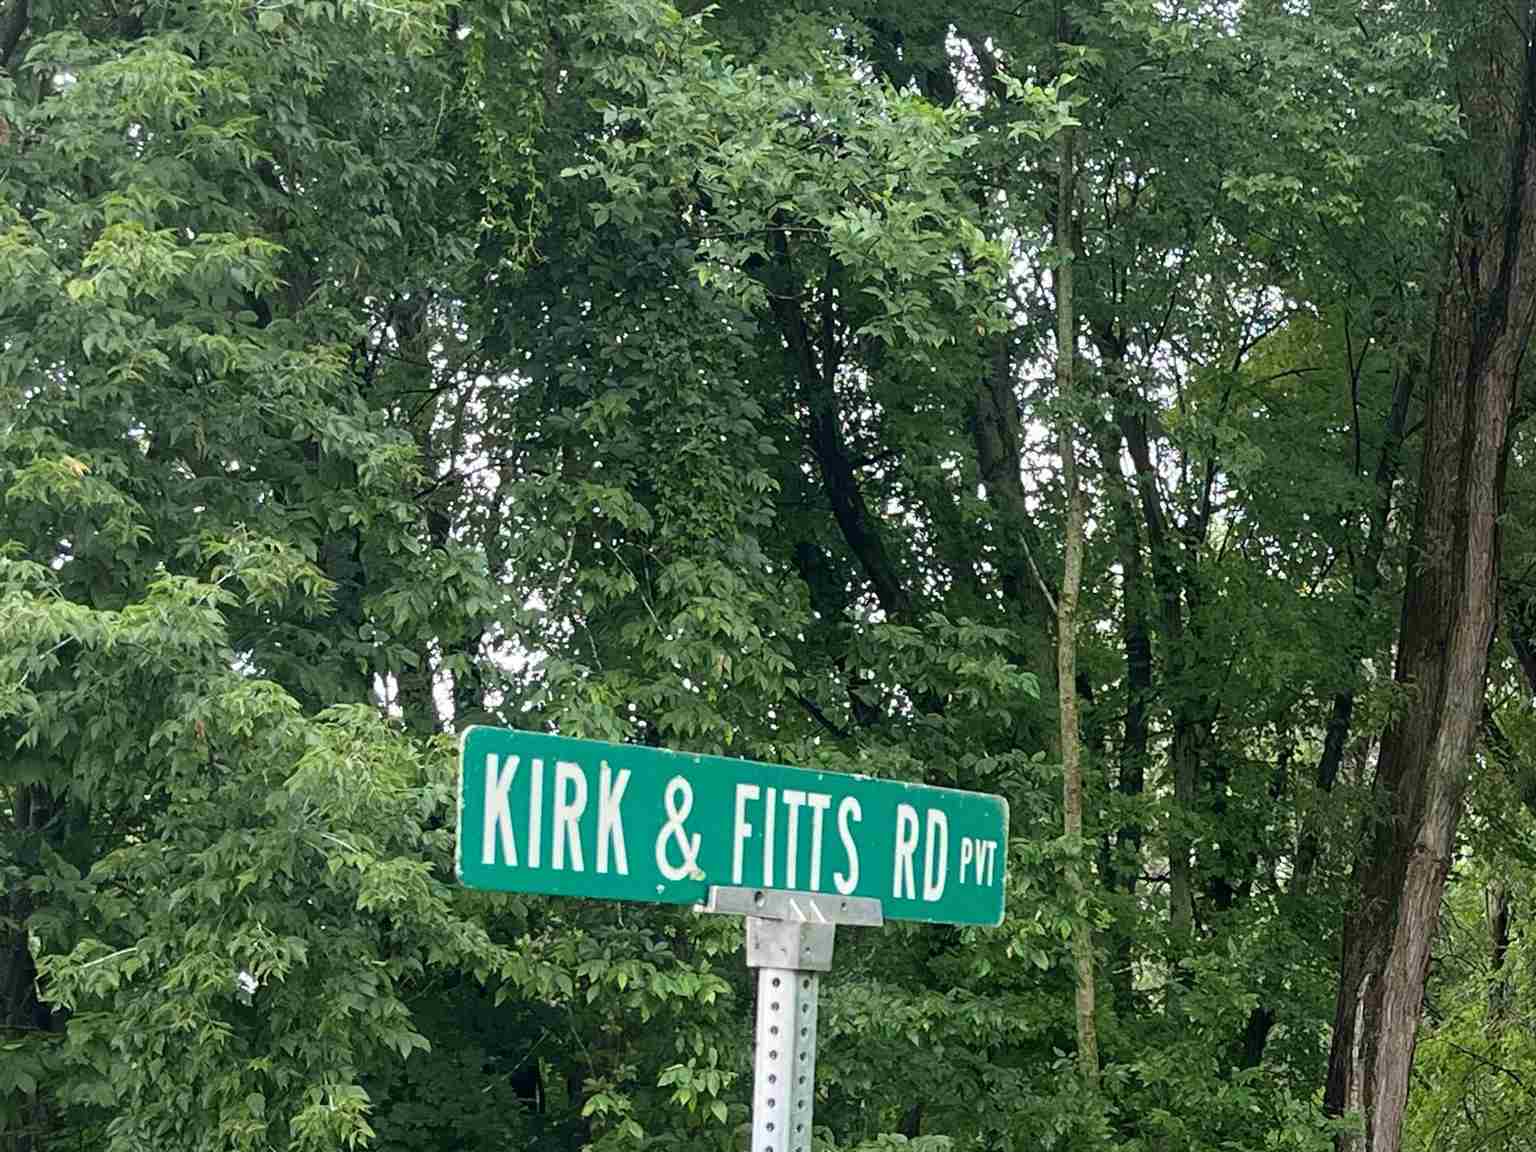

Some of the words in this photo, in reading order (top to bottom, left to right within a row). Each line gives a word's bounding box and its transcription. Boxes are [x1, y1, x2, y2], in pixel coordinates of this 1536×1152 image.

[481, 752, 632, 876] KIRK
[655, 775, 703, 881] &
[731, 782, 863, 895] FITTS
[892, 803, 949, 902] RD
[959, 837, 999, 888] PVT
